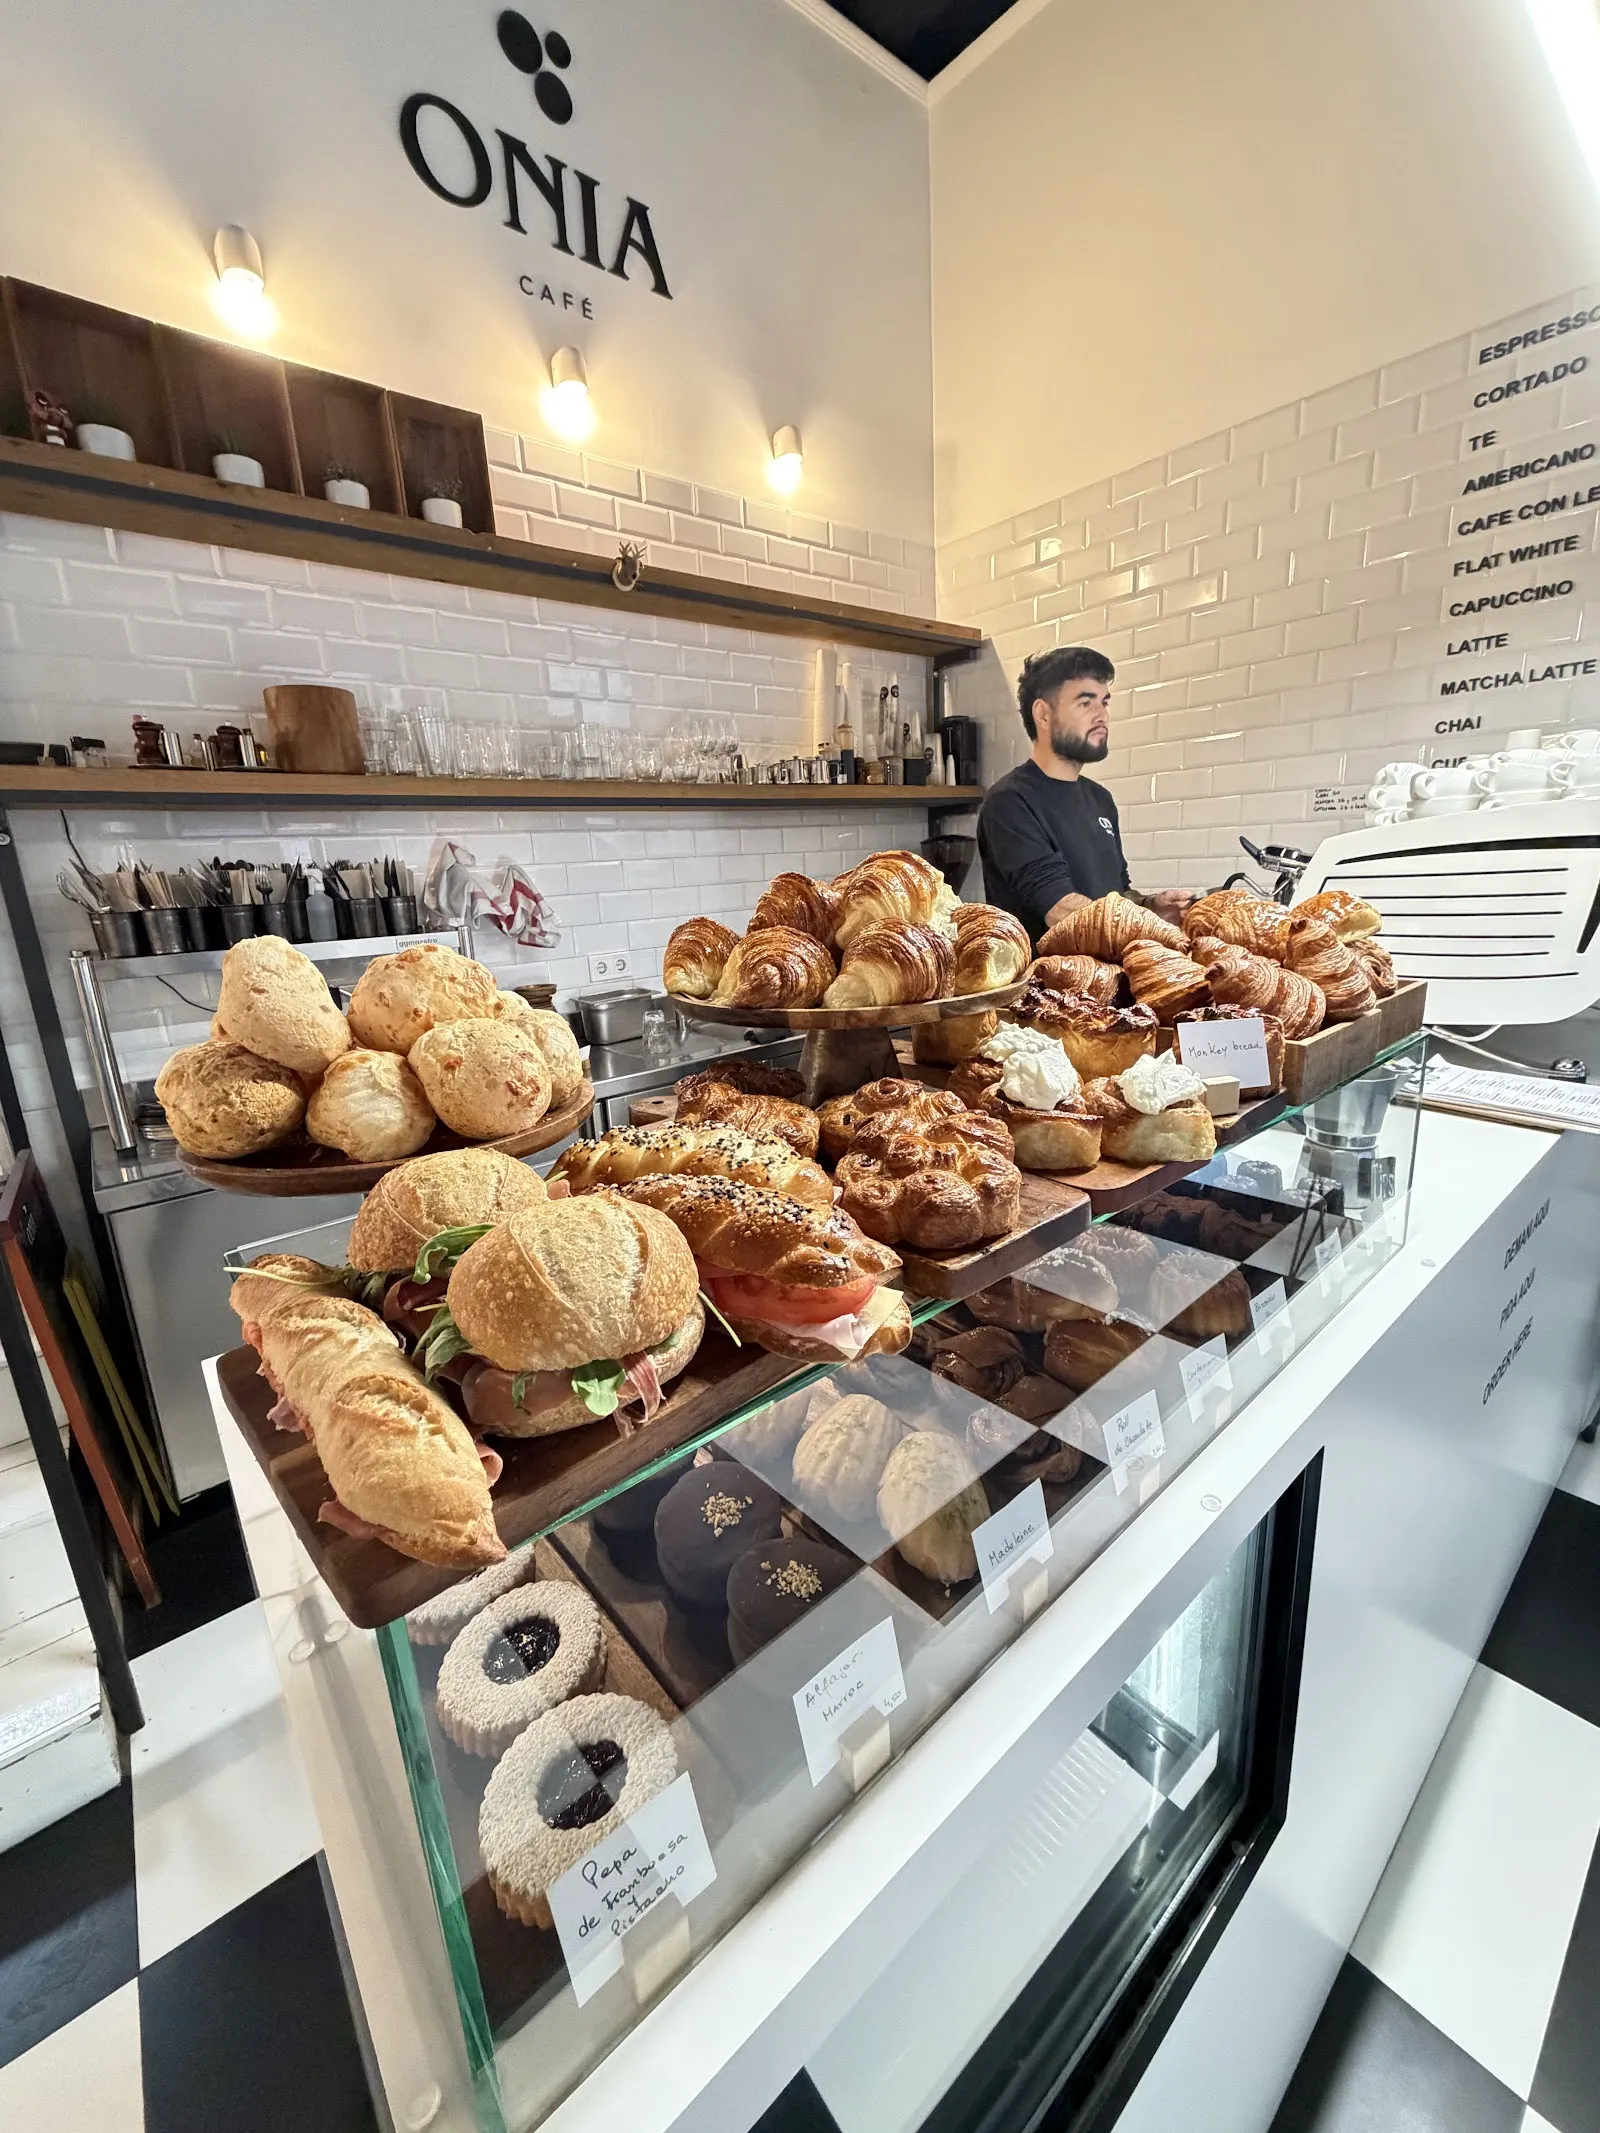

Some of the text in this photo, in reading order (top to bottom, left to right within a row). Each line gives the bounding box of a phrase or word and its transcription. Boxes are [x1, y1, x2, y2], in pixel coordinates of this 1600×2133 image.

[400, 92, 673, 300] ONIA
[519, 275, 594, 320] CAFÉ
[1473, 356, 1587, 408] CORTADO
[1468, 430, 1497, 452] TE
[1462, 443, 1595, 495] AMERICANO
[1457, 510, 1513, 536] CAFE
[1518, 495, 1566, 520] CON
[1452, 534, 1580, 577] FLAT WHITE
[1449, 579, 1574, 617] CAPUCCINO
[1446, 633, 1509, 656] LATTE
[1440, 658, 1598, 696] MATCHA LATTE
[1434, 716, 1482, 734] CHAI
[988, 1524, 1035, 1566] Madeleine
[581, 1847, 637, 1889] Pepa
[578, 1915, 601, 1938] de
